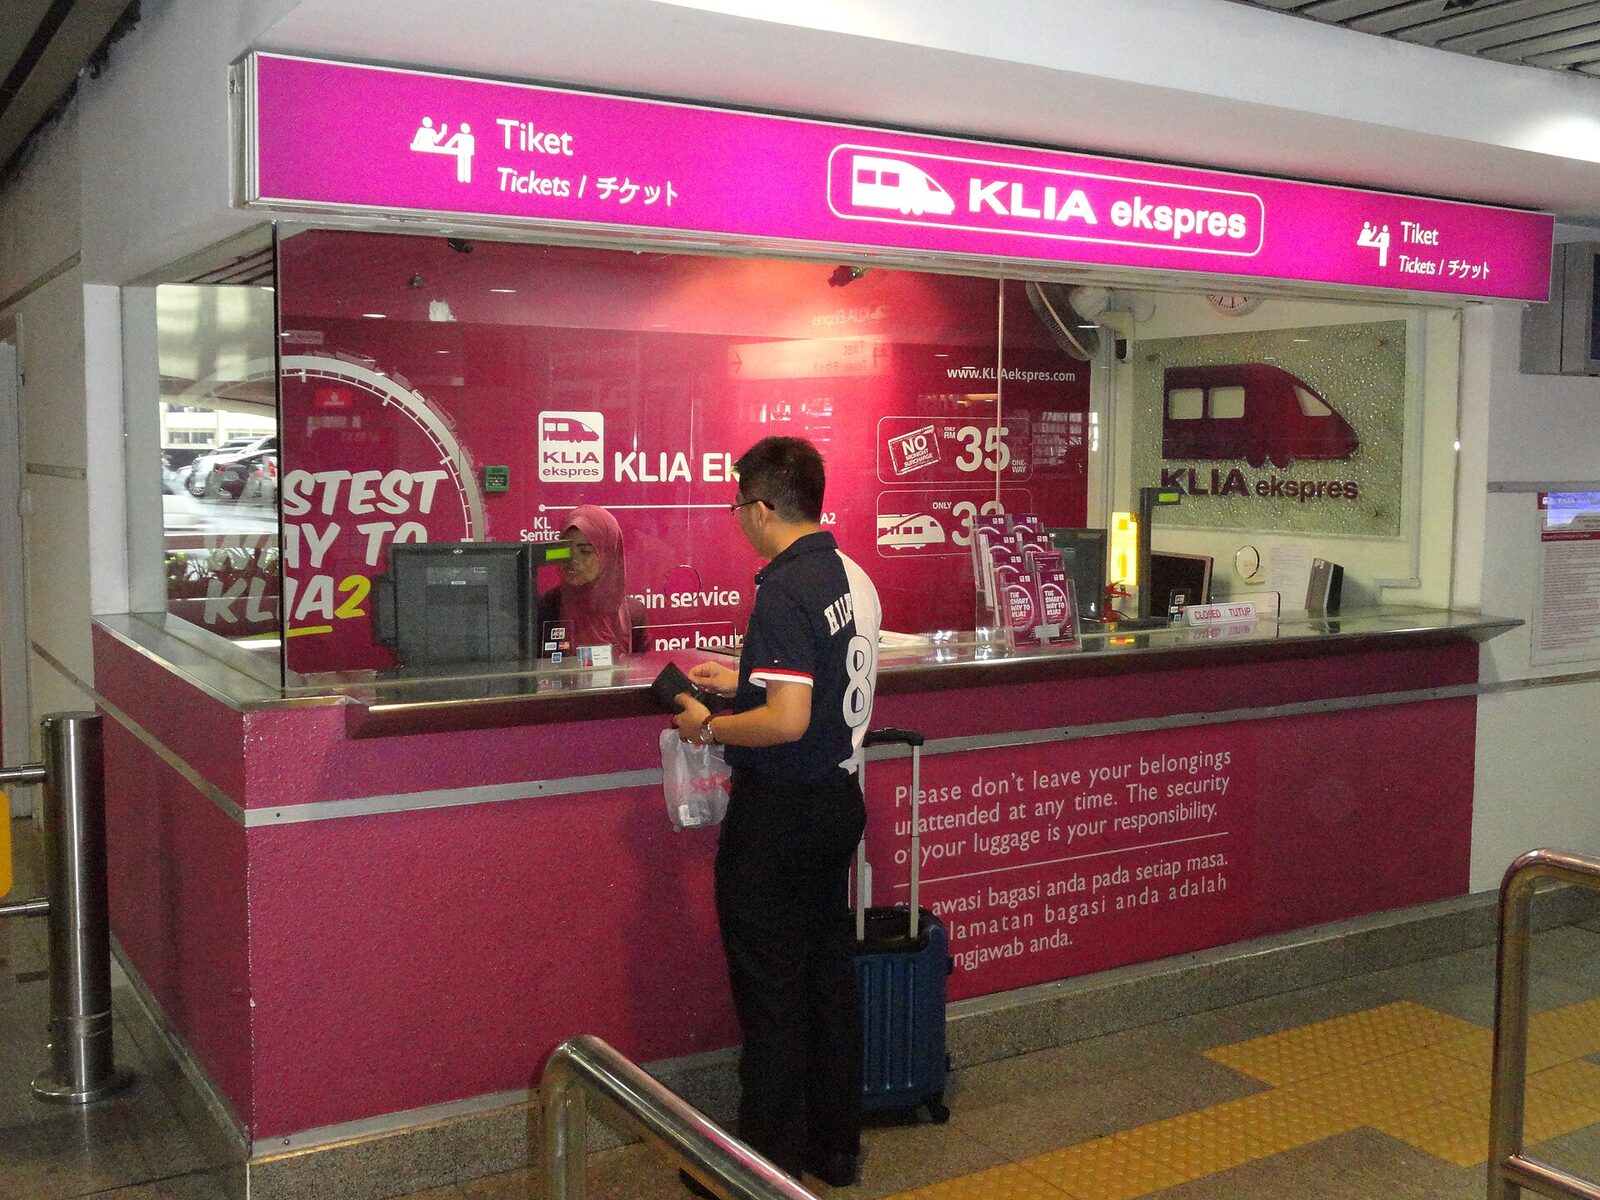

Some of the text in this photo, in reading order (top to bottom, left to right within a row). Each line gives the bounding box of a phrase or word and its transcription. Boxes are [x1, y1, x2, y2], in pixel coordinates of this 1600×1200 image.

[496, 118, 574, 156] Tiket
[497, 167, 679, 207] Tickets / チケット
[968, 178, 1246, 239] KLIA ekspres
[1400, 221, 1439, 246] Tiket
[1399, 255, 1490, 281] Tickets / チケット
[543, 451, 600, 463] KLIA
[902, 435, 927, 456] NO
[944, 426, 1011, 472] RM 35
[543, 466, 599, 478] ekspres
[614, 451, 692, 483] KLIA
[1011, 465, 1027, 473] WAY
[1160, 467, 1359, 503] KLIA ekspres
[819, 512, 837, 525] A2
[932, 501, 952, 510] ONLY
[533, 516, 552, 529] KL
[670, 585, 740, 608] service
[1194, 607, 1251, 620] CLOSED TUTUP
[843, 634, 873, 728] 8
[895, 750, 1231, 808] Please don't leave your belongings
[1009, 803, 1027, 820] at
[1035, 799, 1065, 819] any
[1074, 791, 1117, 811] time.
[1126, 783, 1158, 803] The
[1166, 774, 1230, 798] security
[895, 800, 1218, 867] o your luggage is your responsibility.
[932, 853, 1228, 916] awasi bagasi anda pada setiap masa.
[950, 872, 1227, 941] lamatan bagasi anda adalah
[1030, 928, 1073, 953] anda.
